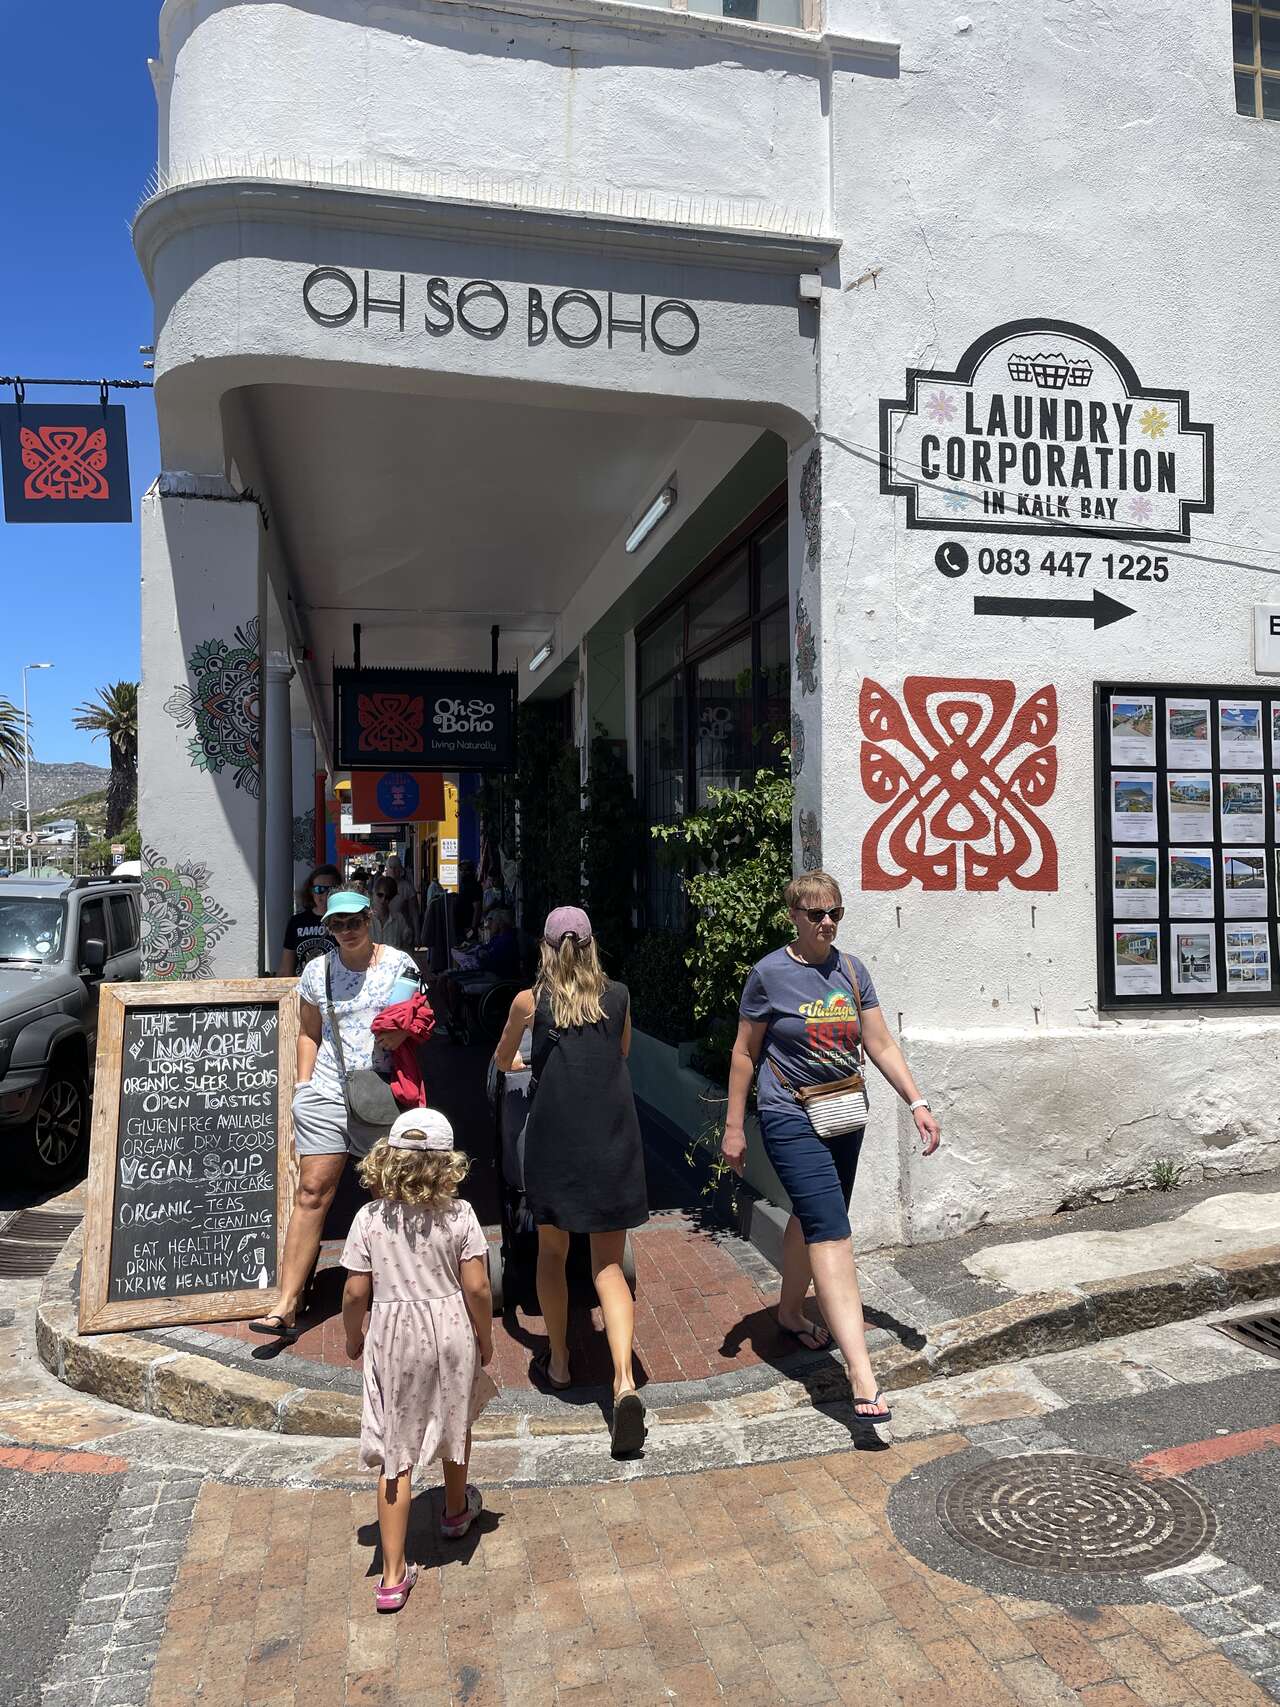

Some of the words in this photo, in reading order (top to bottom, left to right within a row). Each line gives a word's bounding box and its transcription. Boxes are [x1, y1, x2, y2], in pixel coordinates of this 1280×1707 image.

[303, 266, 405, 333] OH
[425, 277, 508, 340] SO
[528, 287, 700, 356] BOHO
[965, 391, 1133, 445] LAUNDRY
[921, 434, 1176, 493] CORPORATION
[983, 491, 1005, 515] IN
[1017, 493, 1070, 519] KALK
[1081, 496, 1118, 520] BAY
[978, 547, 1031, 576] 083
[1040, 551, 1092, 578] 447
[1102, 553, 1169, 582] 1225
[434, 698, 467, 716] Oh
[467, 699, 495, 718] So
[433, 714, 494, 733] Boho
[432, 739, 456, 751] Living
[457, 740, 497, 752] Naturally
[26, 834, 33, 844] S
[132, 1011, 178, 1036] THE
[191, 1005, 262, 1034] PANTRY
[799, 998, 855, 1020] Vintage
[153, 1035, 203, 1059] NOW
[207, 1031, 262, 1056] OPEN
[148, 1059, 195, 1075] LIONS
[204, 1056, 257, 1073] MANE
[123, 1075, 180, 1095] ORGANIC
[184, 1074, 228, 1091] SUPER
[237, 1070, 278, 1089] FOODS
[142, 1093, 190, 1113] OPEN
[196, 1091, 272, 1110] TOASTIES
[217, 1112, 275, 1130] AVAILABLE
[122, 1136, 185, 1156] ORGANIC
[194, 1134, 222, 1150] DRY
[228, 1130, 275, 1147] FOODS
[120, 1157, 192, 1185] VEGAN
[202, 1153, 263, 1179] SOUP
[120, 1200, 193, 1226] ORGANIC
[206, 1197, 244, 1212] TEAS
[203, 1208, 273, 1230] CLEANING
[133, 1240, 160, 1259] EAT
[168, 1234, 232, 1255] HEALTHY
[126, 1256, 168, 1277] DRINK
[173, 1250, 234, 1269] HEALTHY
[176, 1268, 239, 1289] HEALTHY
